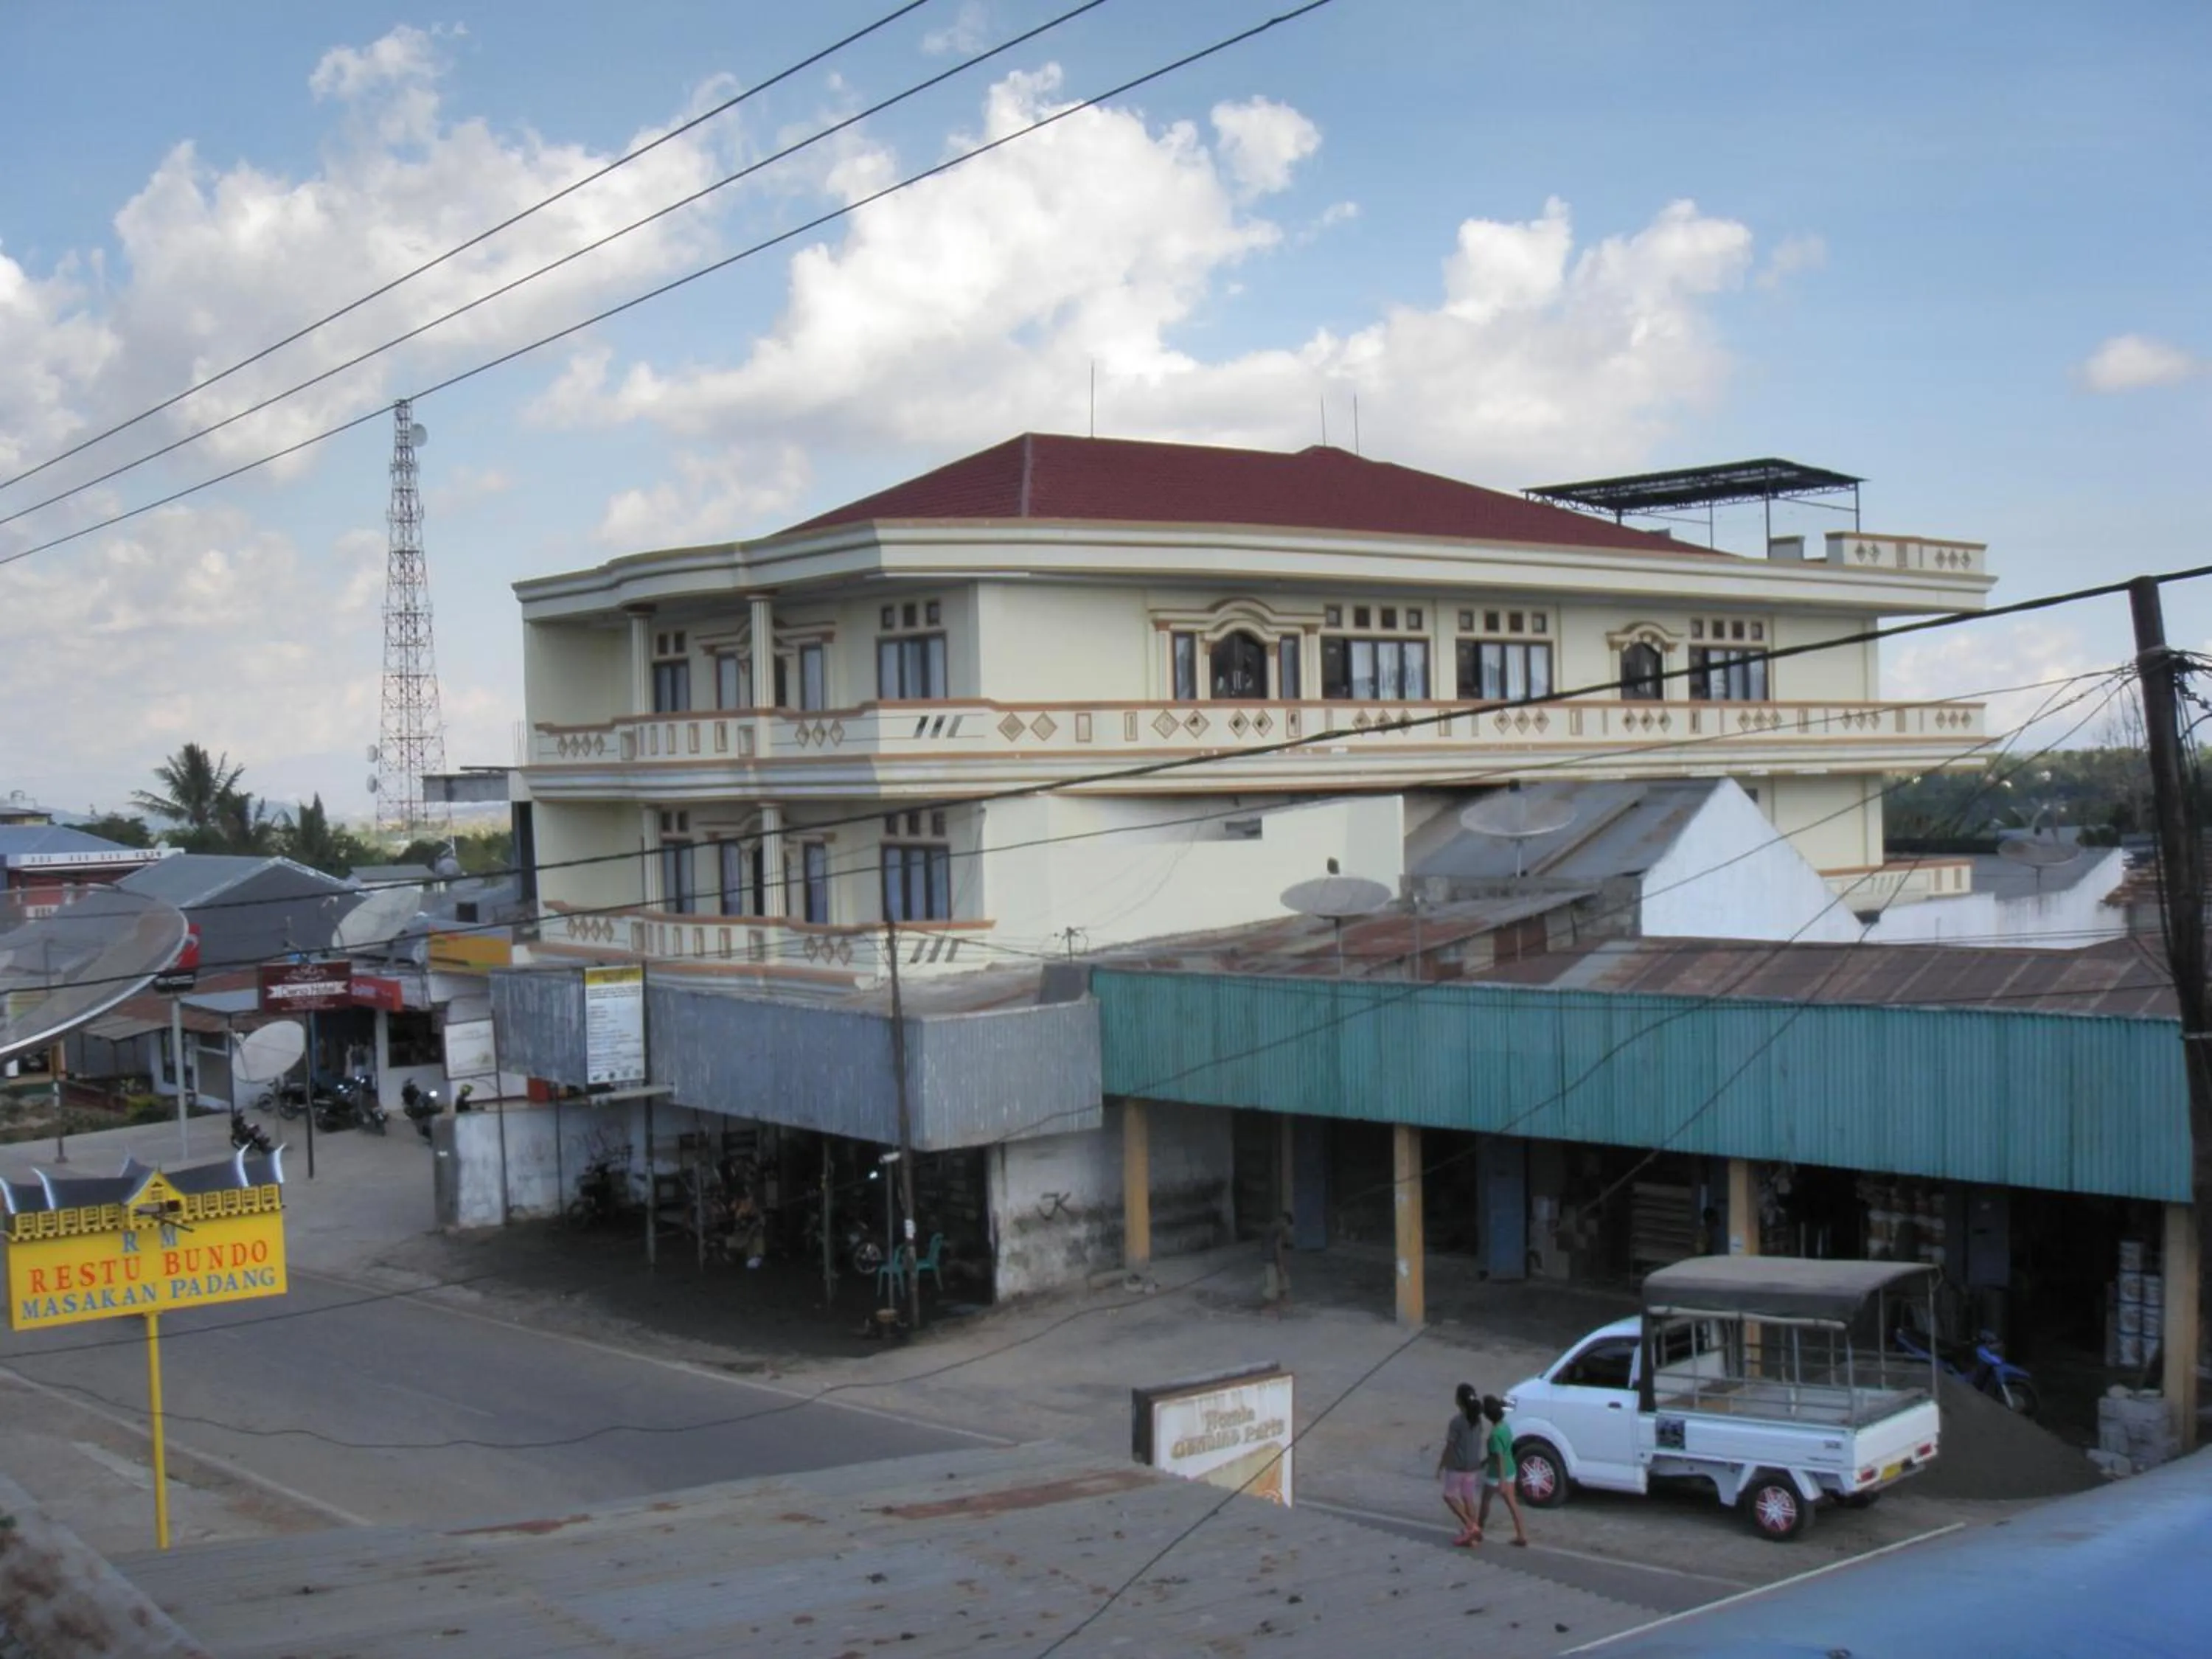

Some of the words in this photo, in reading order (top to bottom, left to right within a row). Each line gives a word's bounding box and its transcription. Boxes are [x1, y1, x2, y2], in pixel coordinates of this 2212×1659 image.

[29, 1256, 141, 1294] RESTU
[164, 1239, 268, 1276] BUNDO
[122, 1231, 140, 1252] R
[21, 1282, 158, 1321] MASAKAN
[170, 1266, 276, 1299] PADANG
